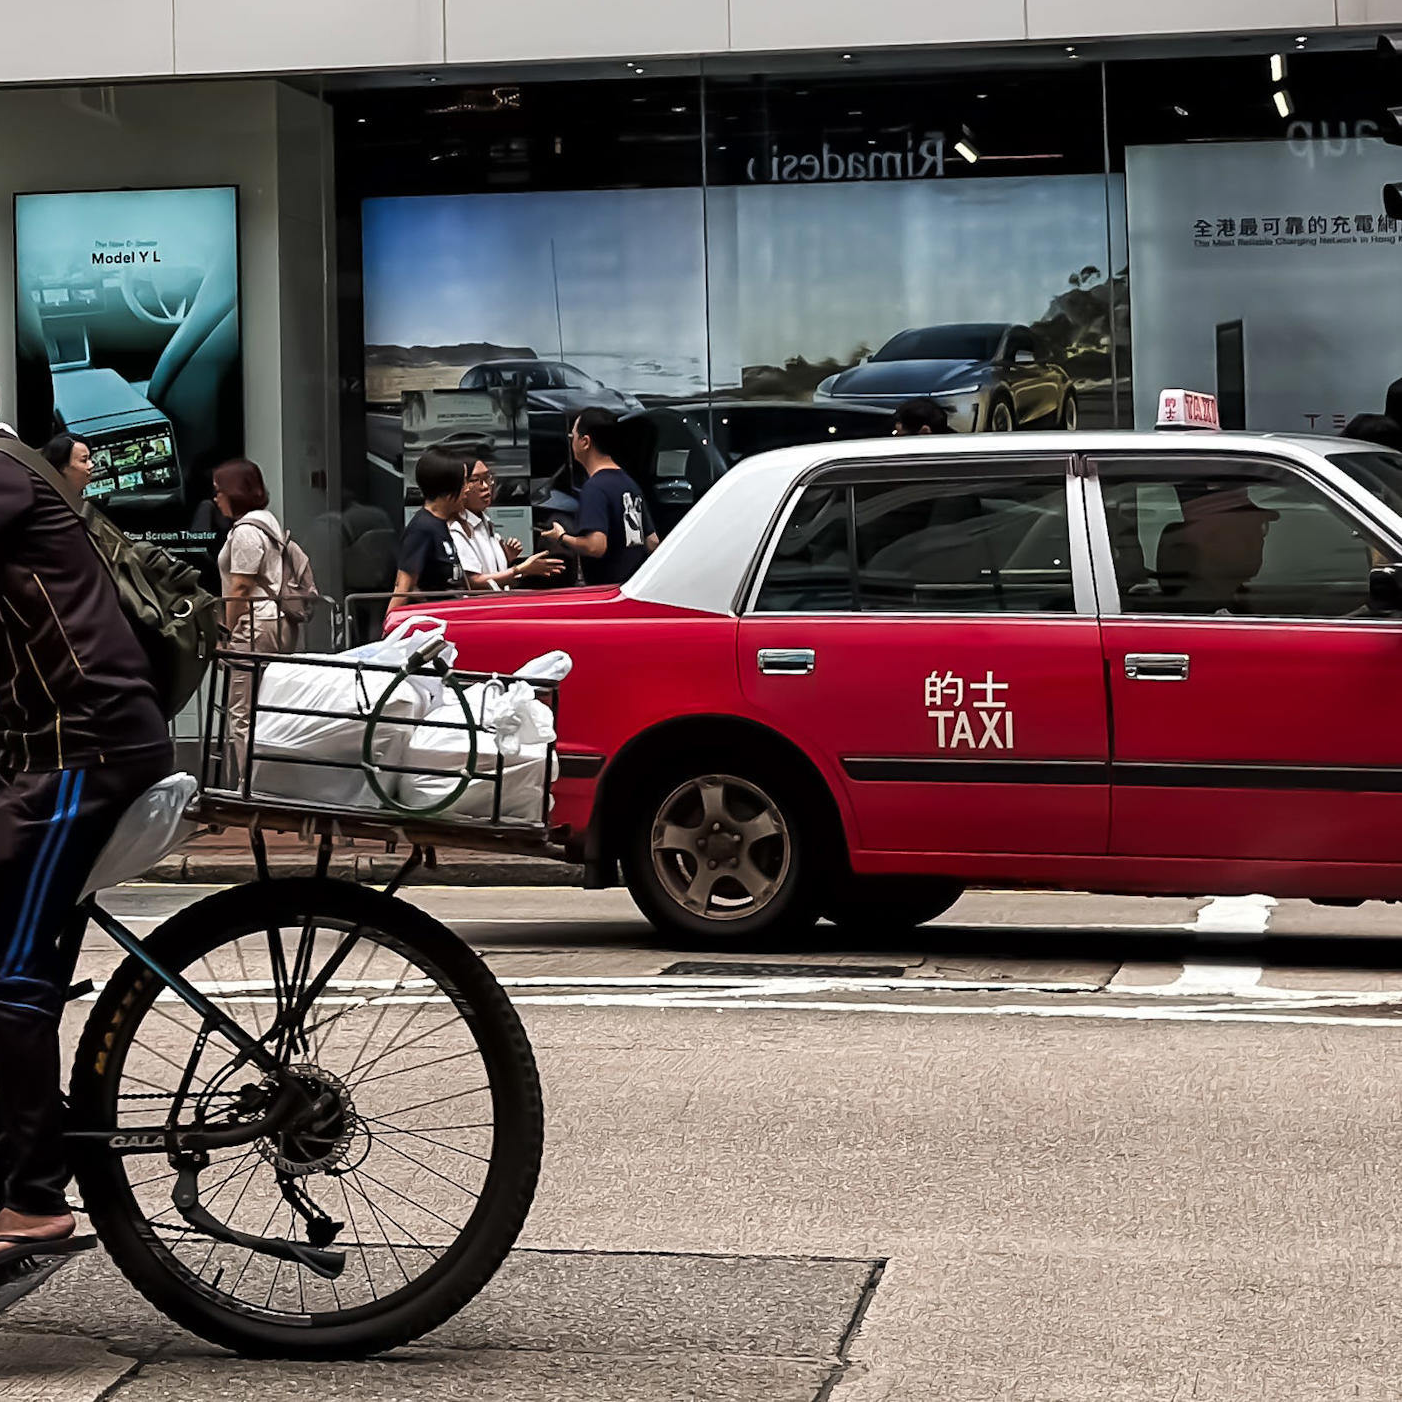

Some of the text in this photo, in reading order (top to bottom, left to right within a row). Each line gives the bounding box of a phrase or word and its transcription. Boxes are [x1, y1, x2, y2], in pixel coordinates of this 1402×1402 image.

[1194, 214, 1402, 237] 全港最可靠的充電網
[92, 251, 161, 264] Model Y L
[1184, 393, 1217, 424] TAXI
[145, 530, 178, 540] Screen
[179, 529, 217, 540] Theater
[924, 670, 1009, 708] 的士
[927, 710, 1014, 749] TAXI
